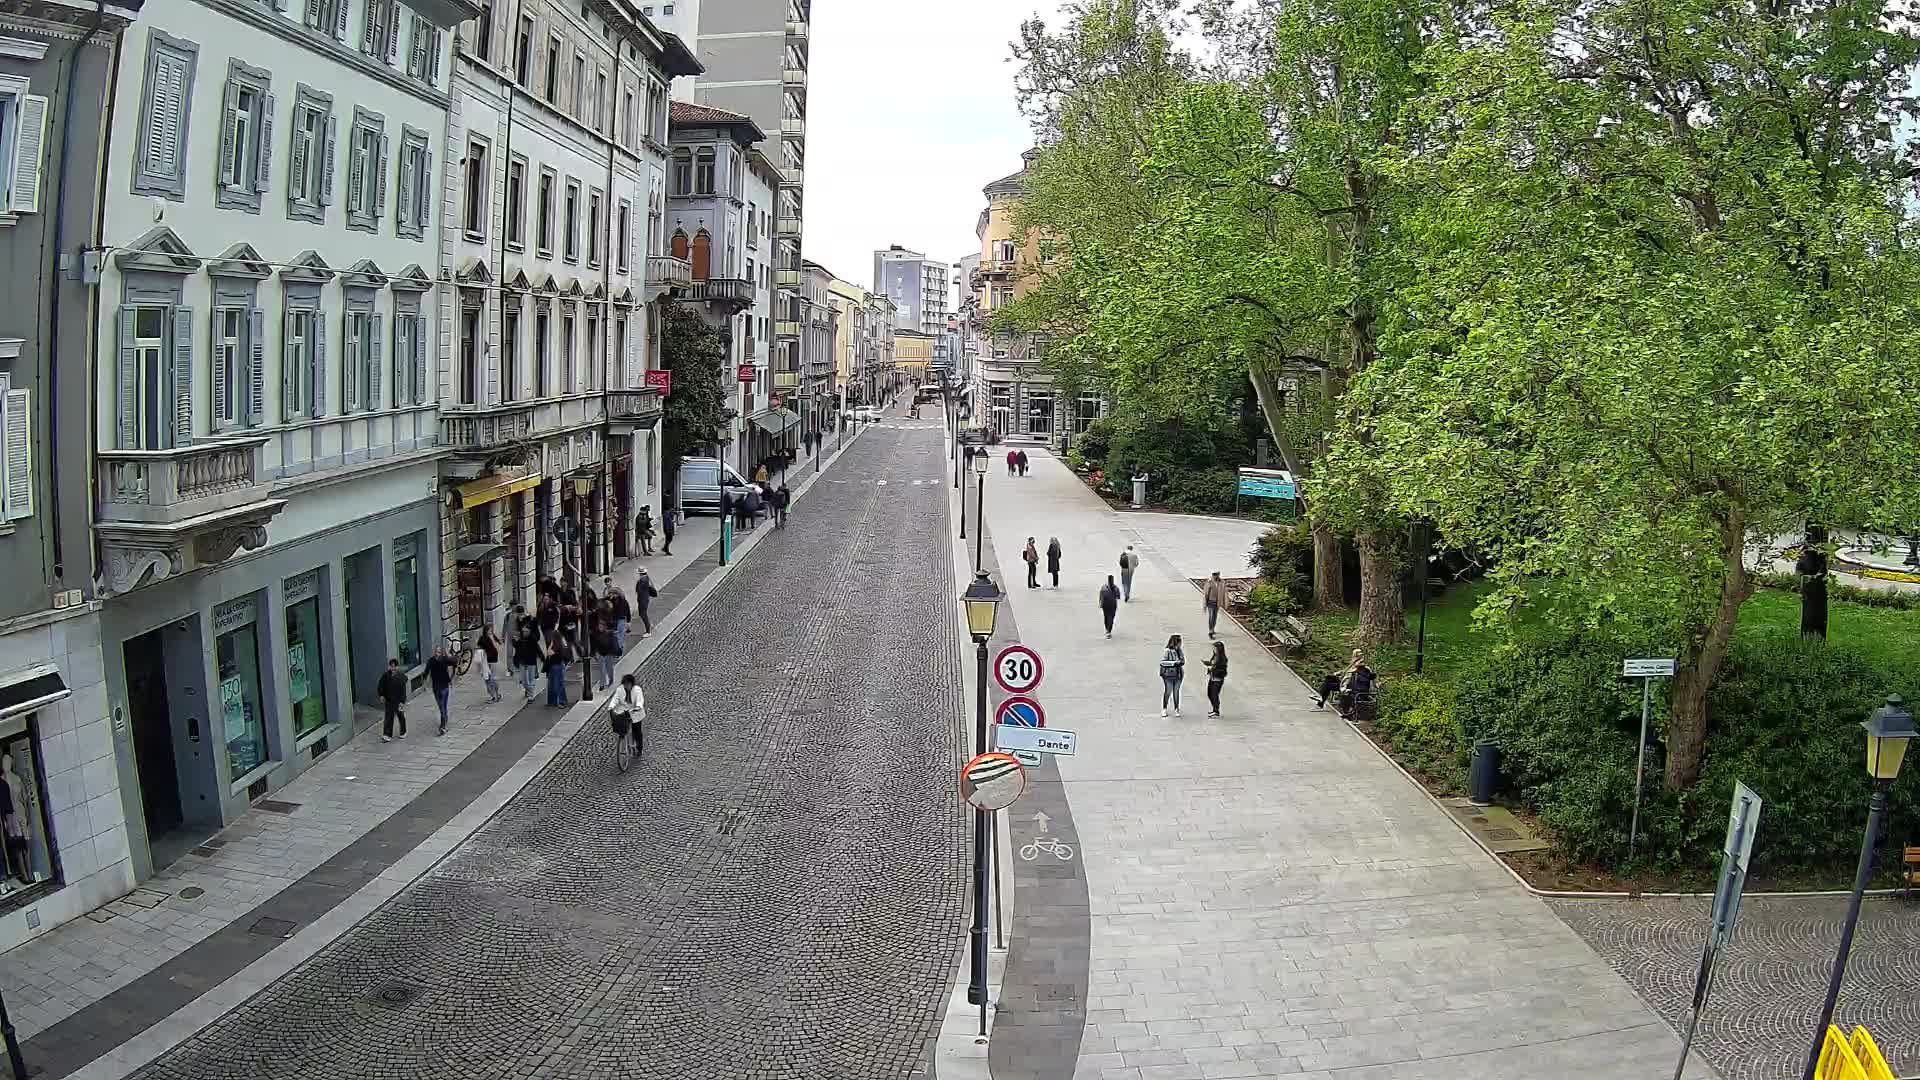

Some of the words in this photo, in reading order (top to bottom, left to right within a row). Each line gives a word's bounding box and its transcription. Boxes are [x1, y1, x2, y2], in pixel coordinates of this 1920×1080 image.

[1005, 659, 1032, 680] 30
[221, 678, 240, 701] 130
[1039, 739, 1069, 749] Dante
